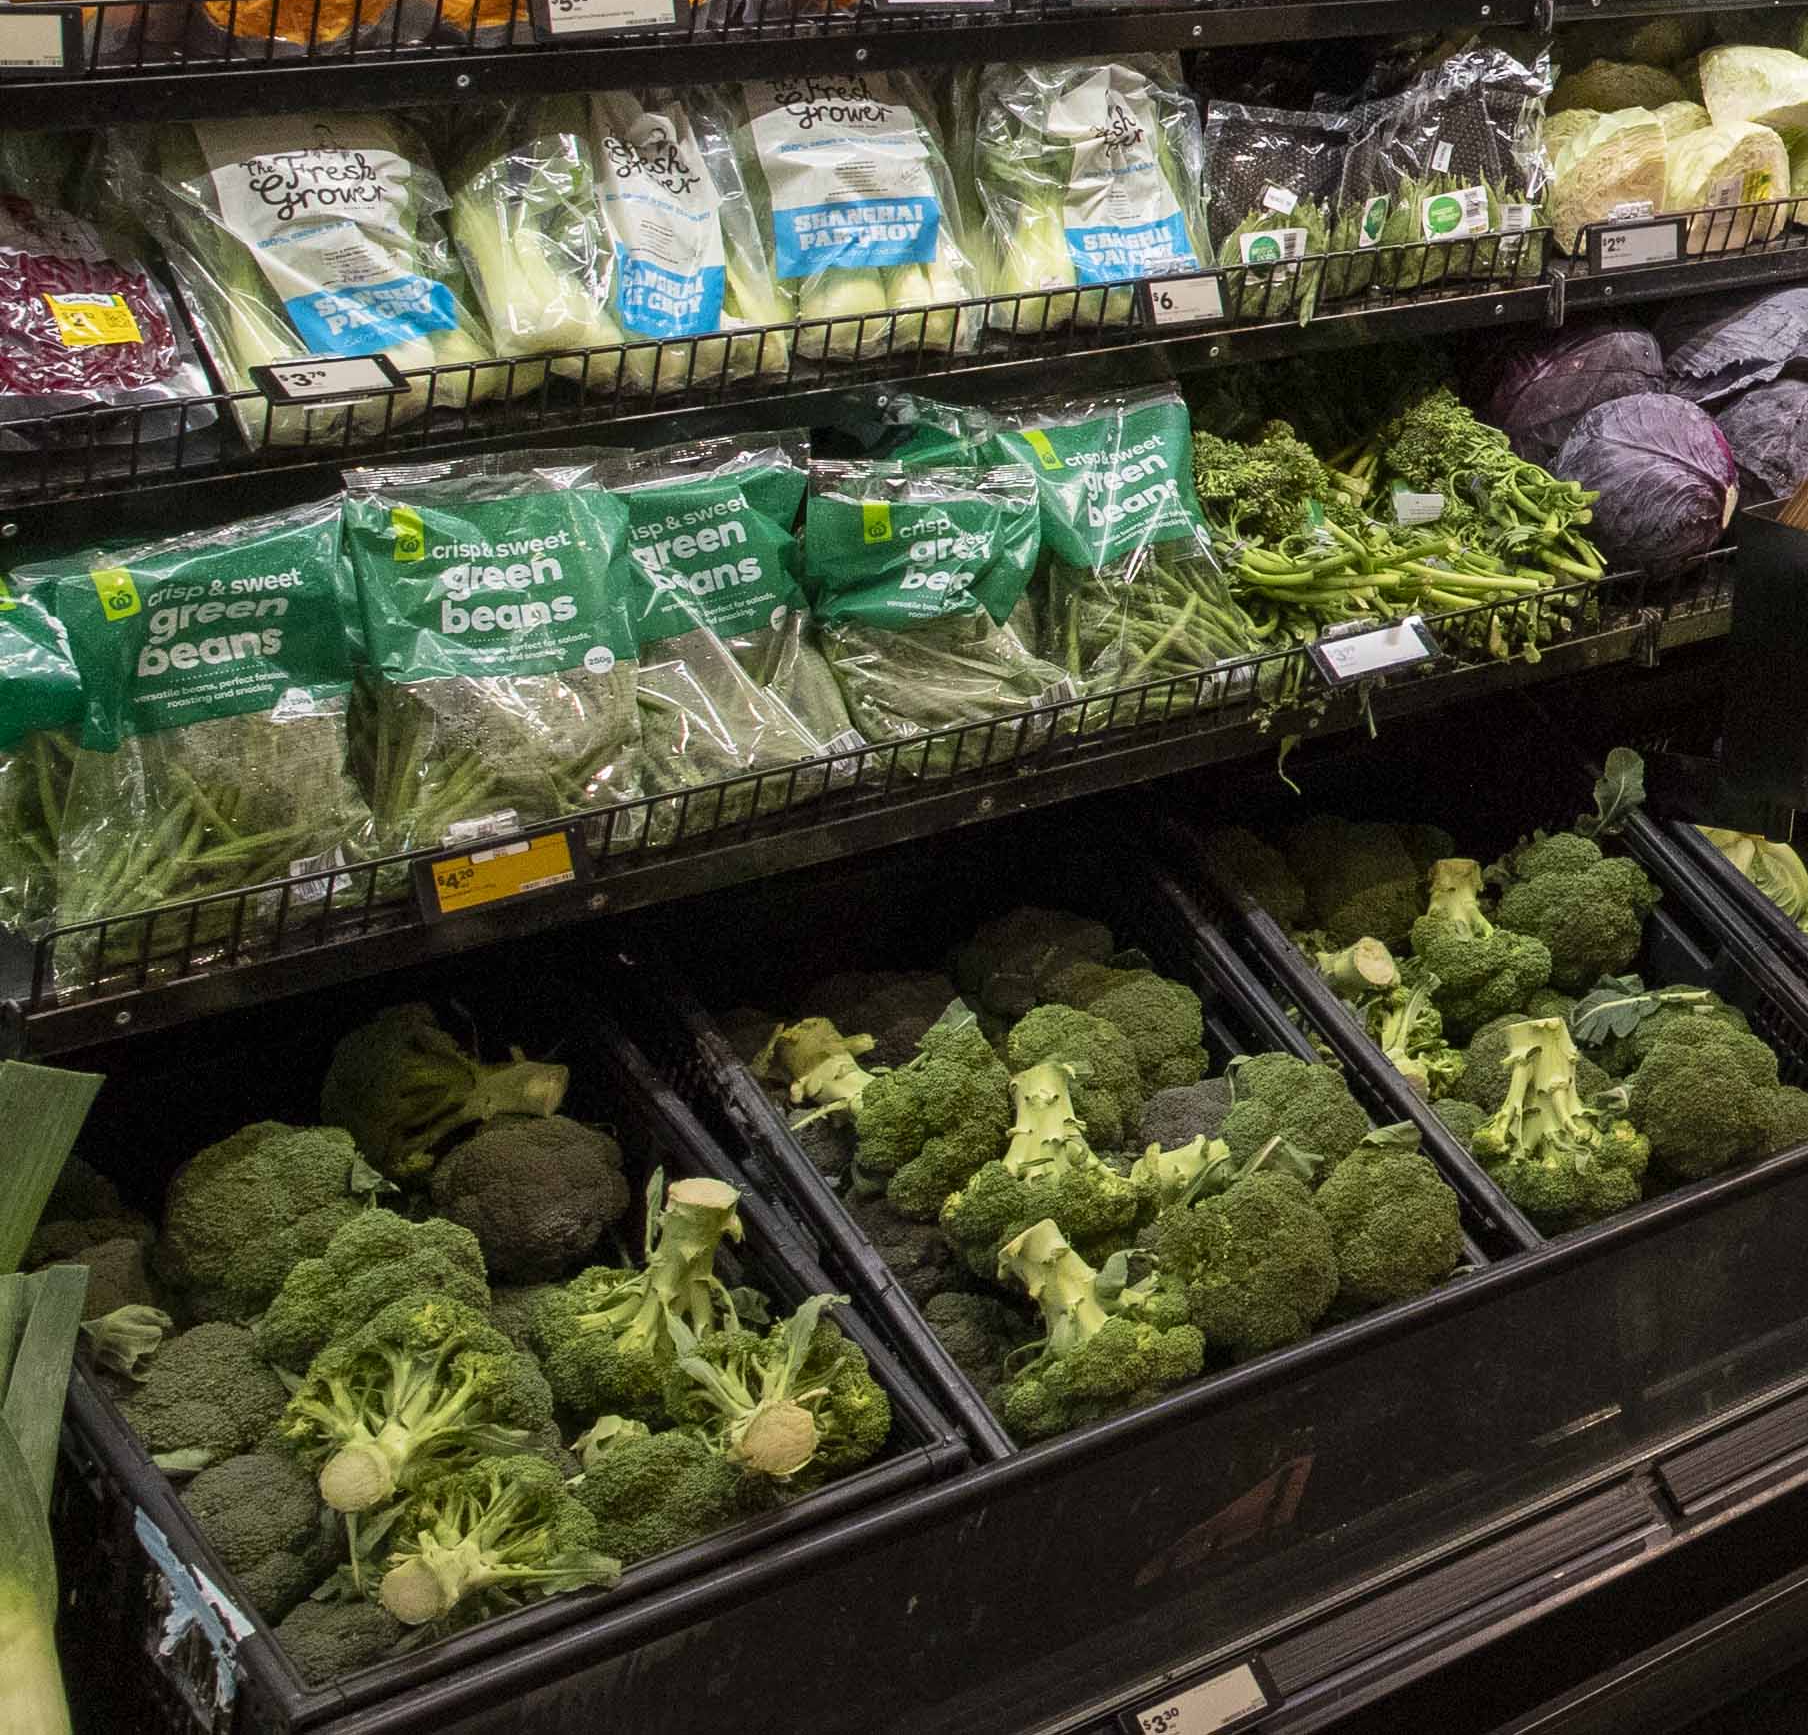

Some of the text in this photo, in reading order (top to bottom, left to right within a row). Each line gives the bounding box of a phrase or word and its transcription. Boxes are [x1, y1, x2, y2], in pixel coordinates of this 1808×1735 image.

[432, 528, 572, 563] crisp sweet
[148, 567, 304, 608] crisp & sweet
[440, 555, 564, 602] green
[148, 596, 289, 645] green
[441, 595, 578, 634] beans
[137, 628, 283, 678] beans
